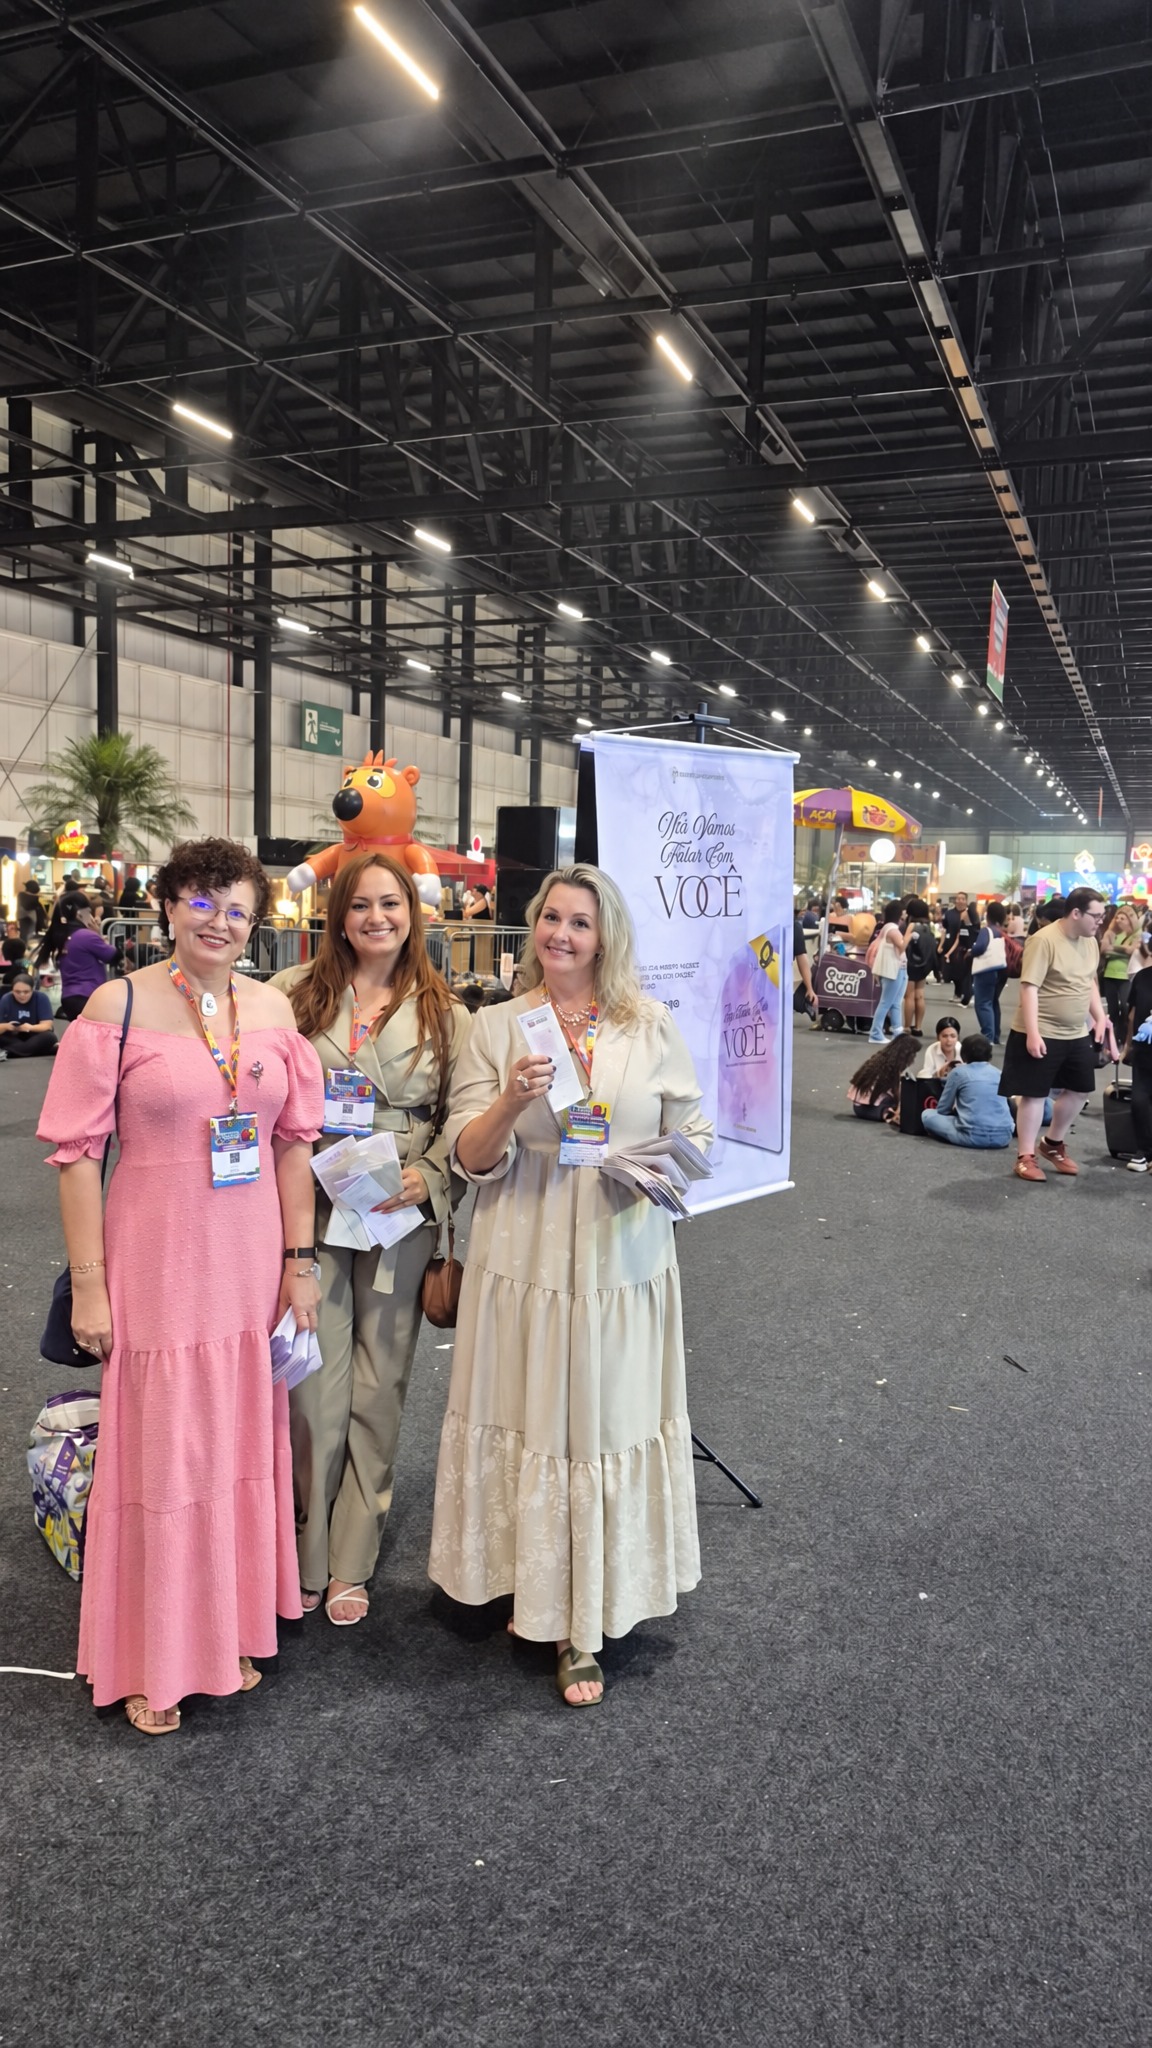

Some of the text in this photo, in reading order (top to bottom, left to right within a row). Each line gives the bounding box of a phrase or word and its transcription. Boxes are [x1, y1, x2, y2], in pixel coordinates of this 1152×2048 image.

[692, 812, 736, 841] Vamos
[660, 840, 703, 869] Falar
[653, 864, 743, 919] VOCÊ
[723, 1015, 767, 1059] VOCÊ
